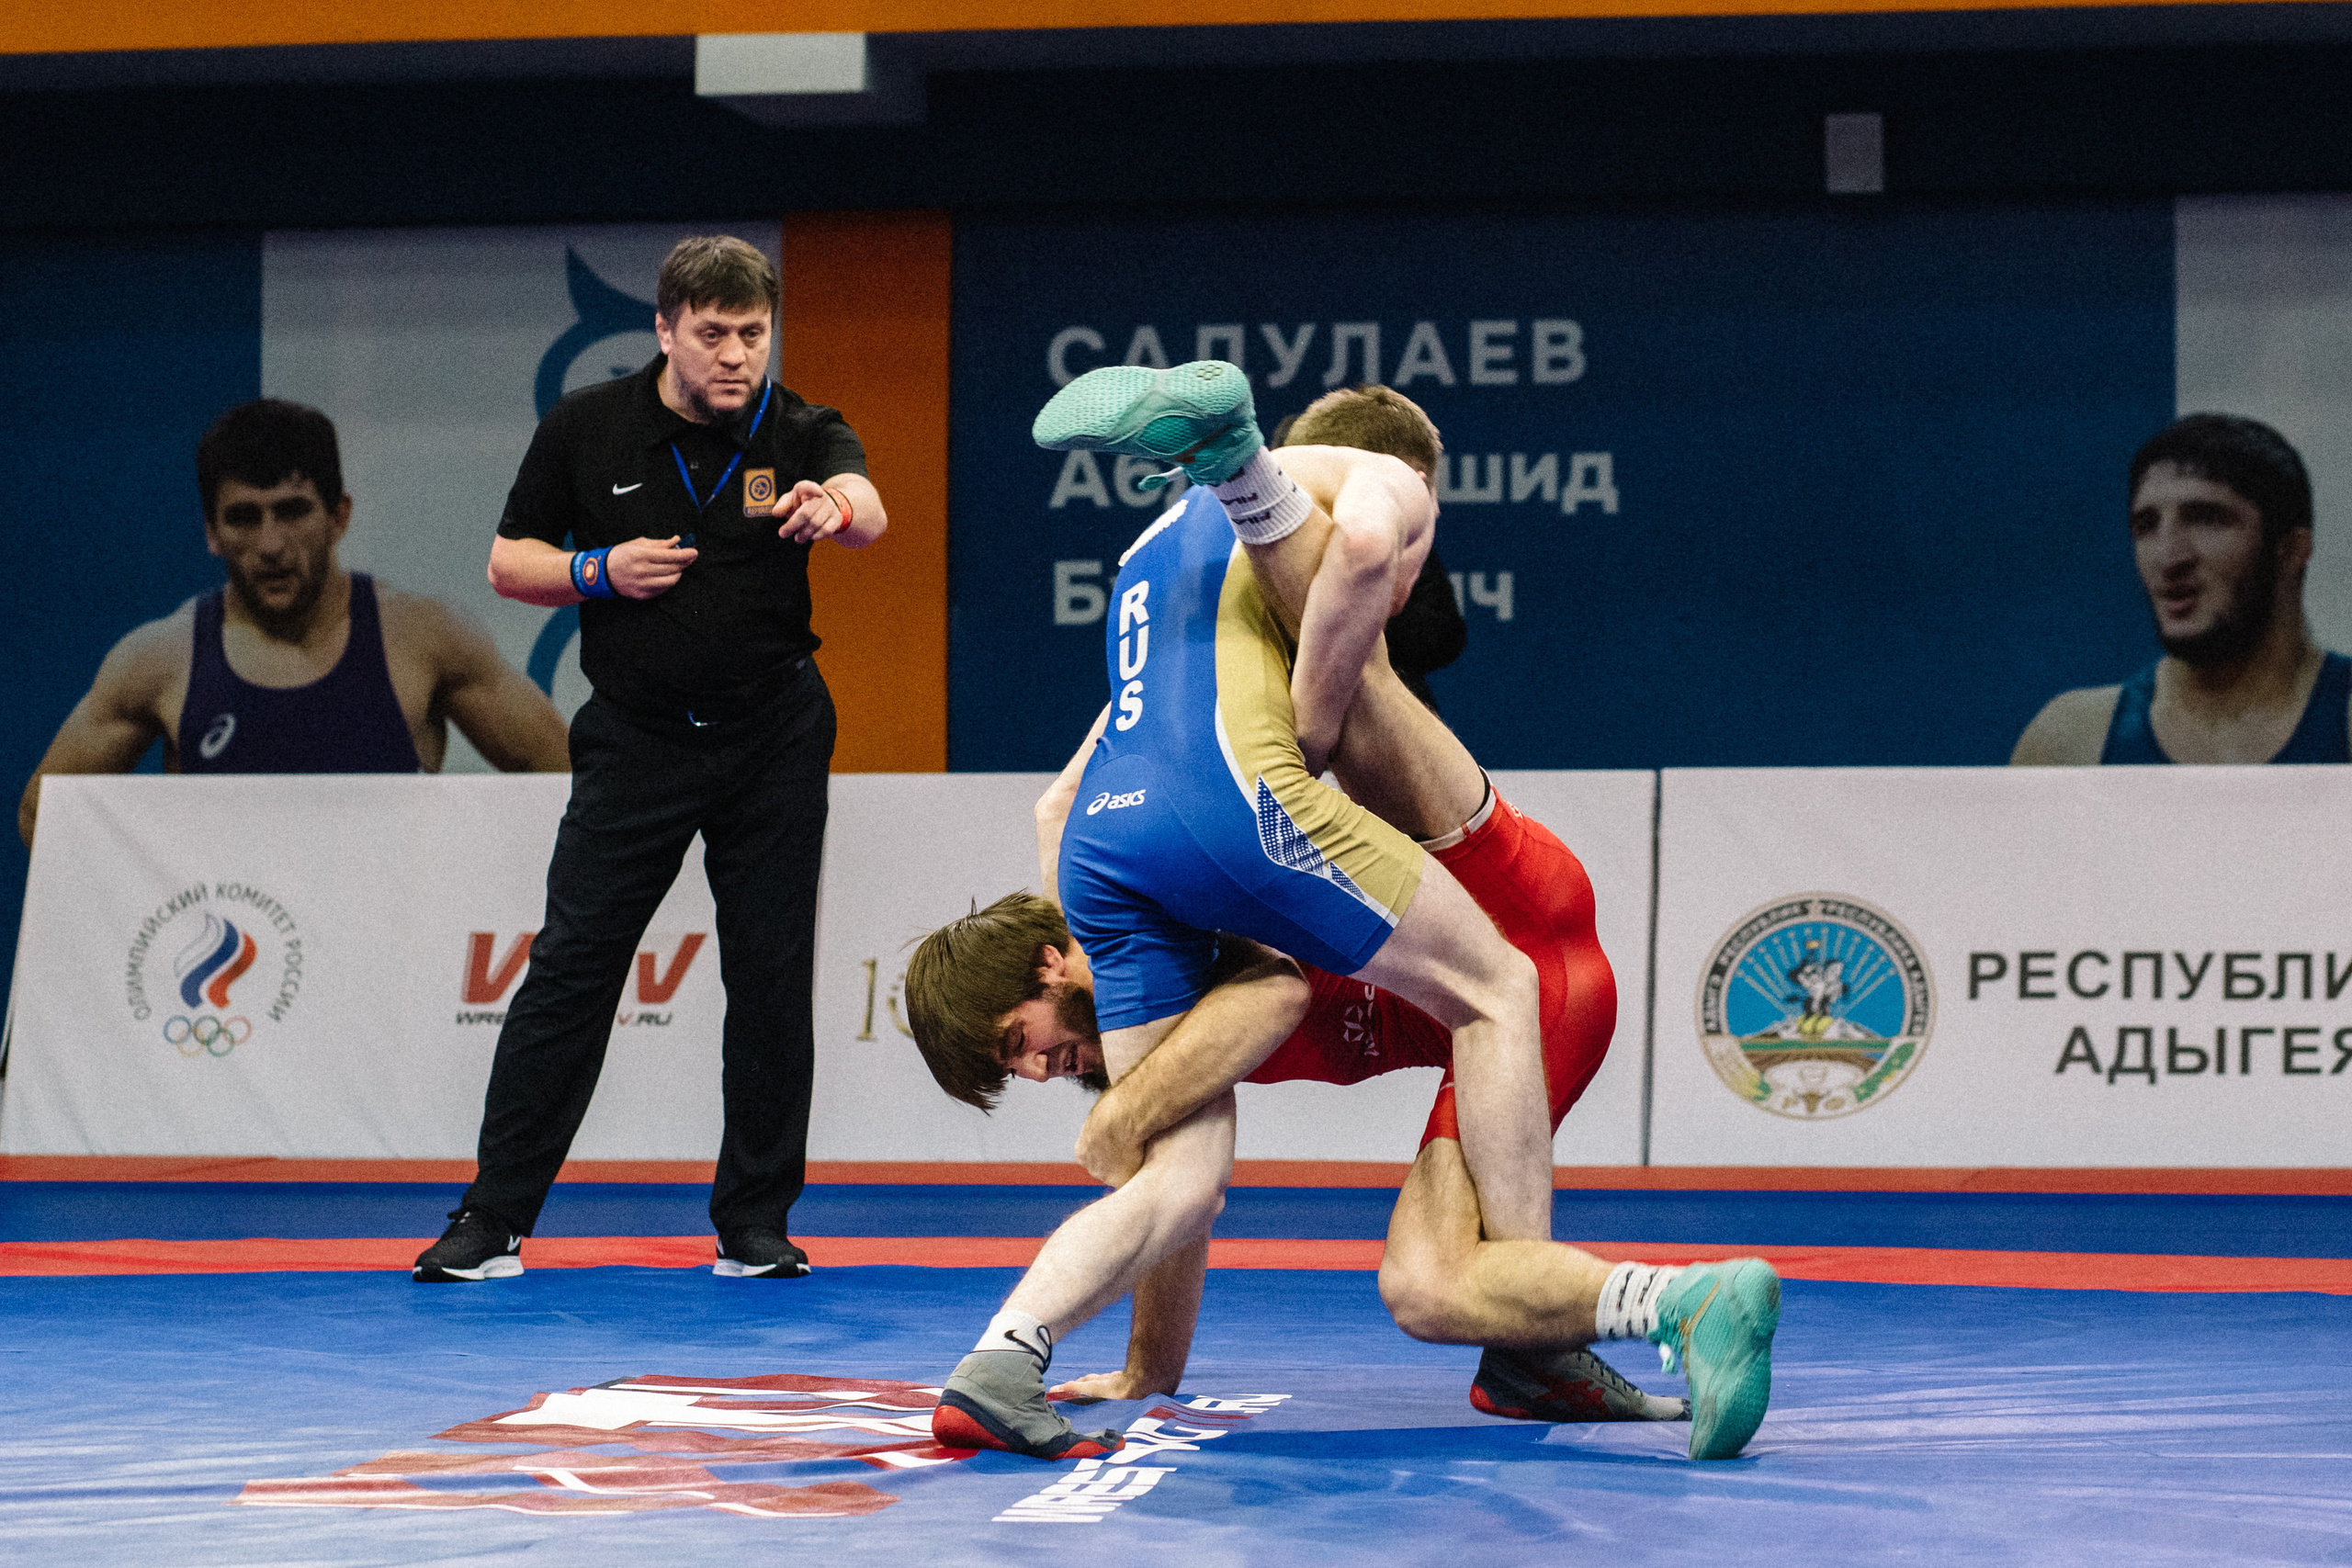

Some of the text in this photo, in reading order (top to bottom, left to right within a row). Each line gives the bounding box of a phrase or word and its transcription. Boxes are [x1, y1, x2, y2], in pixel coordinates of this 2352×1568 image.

[1115, 580, 1149, 731] RUS
[1106, 789, 1146, 809] asics
[127, 883, 303, 1022] ОЛИМПИЙСКИЙ КОМИТЕТ РОССИИ
[1969, 950, 2352, 1000] РЕСПУБЛИ
[2054, 1025, 2352, 1086] АДЫГЕЯ
